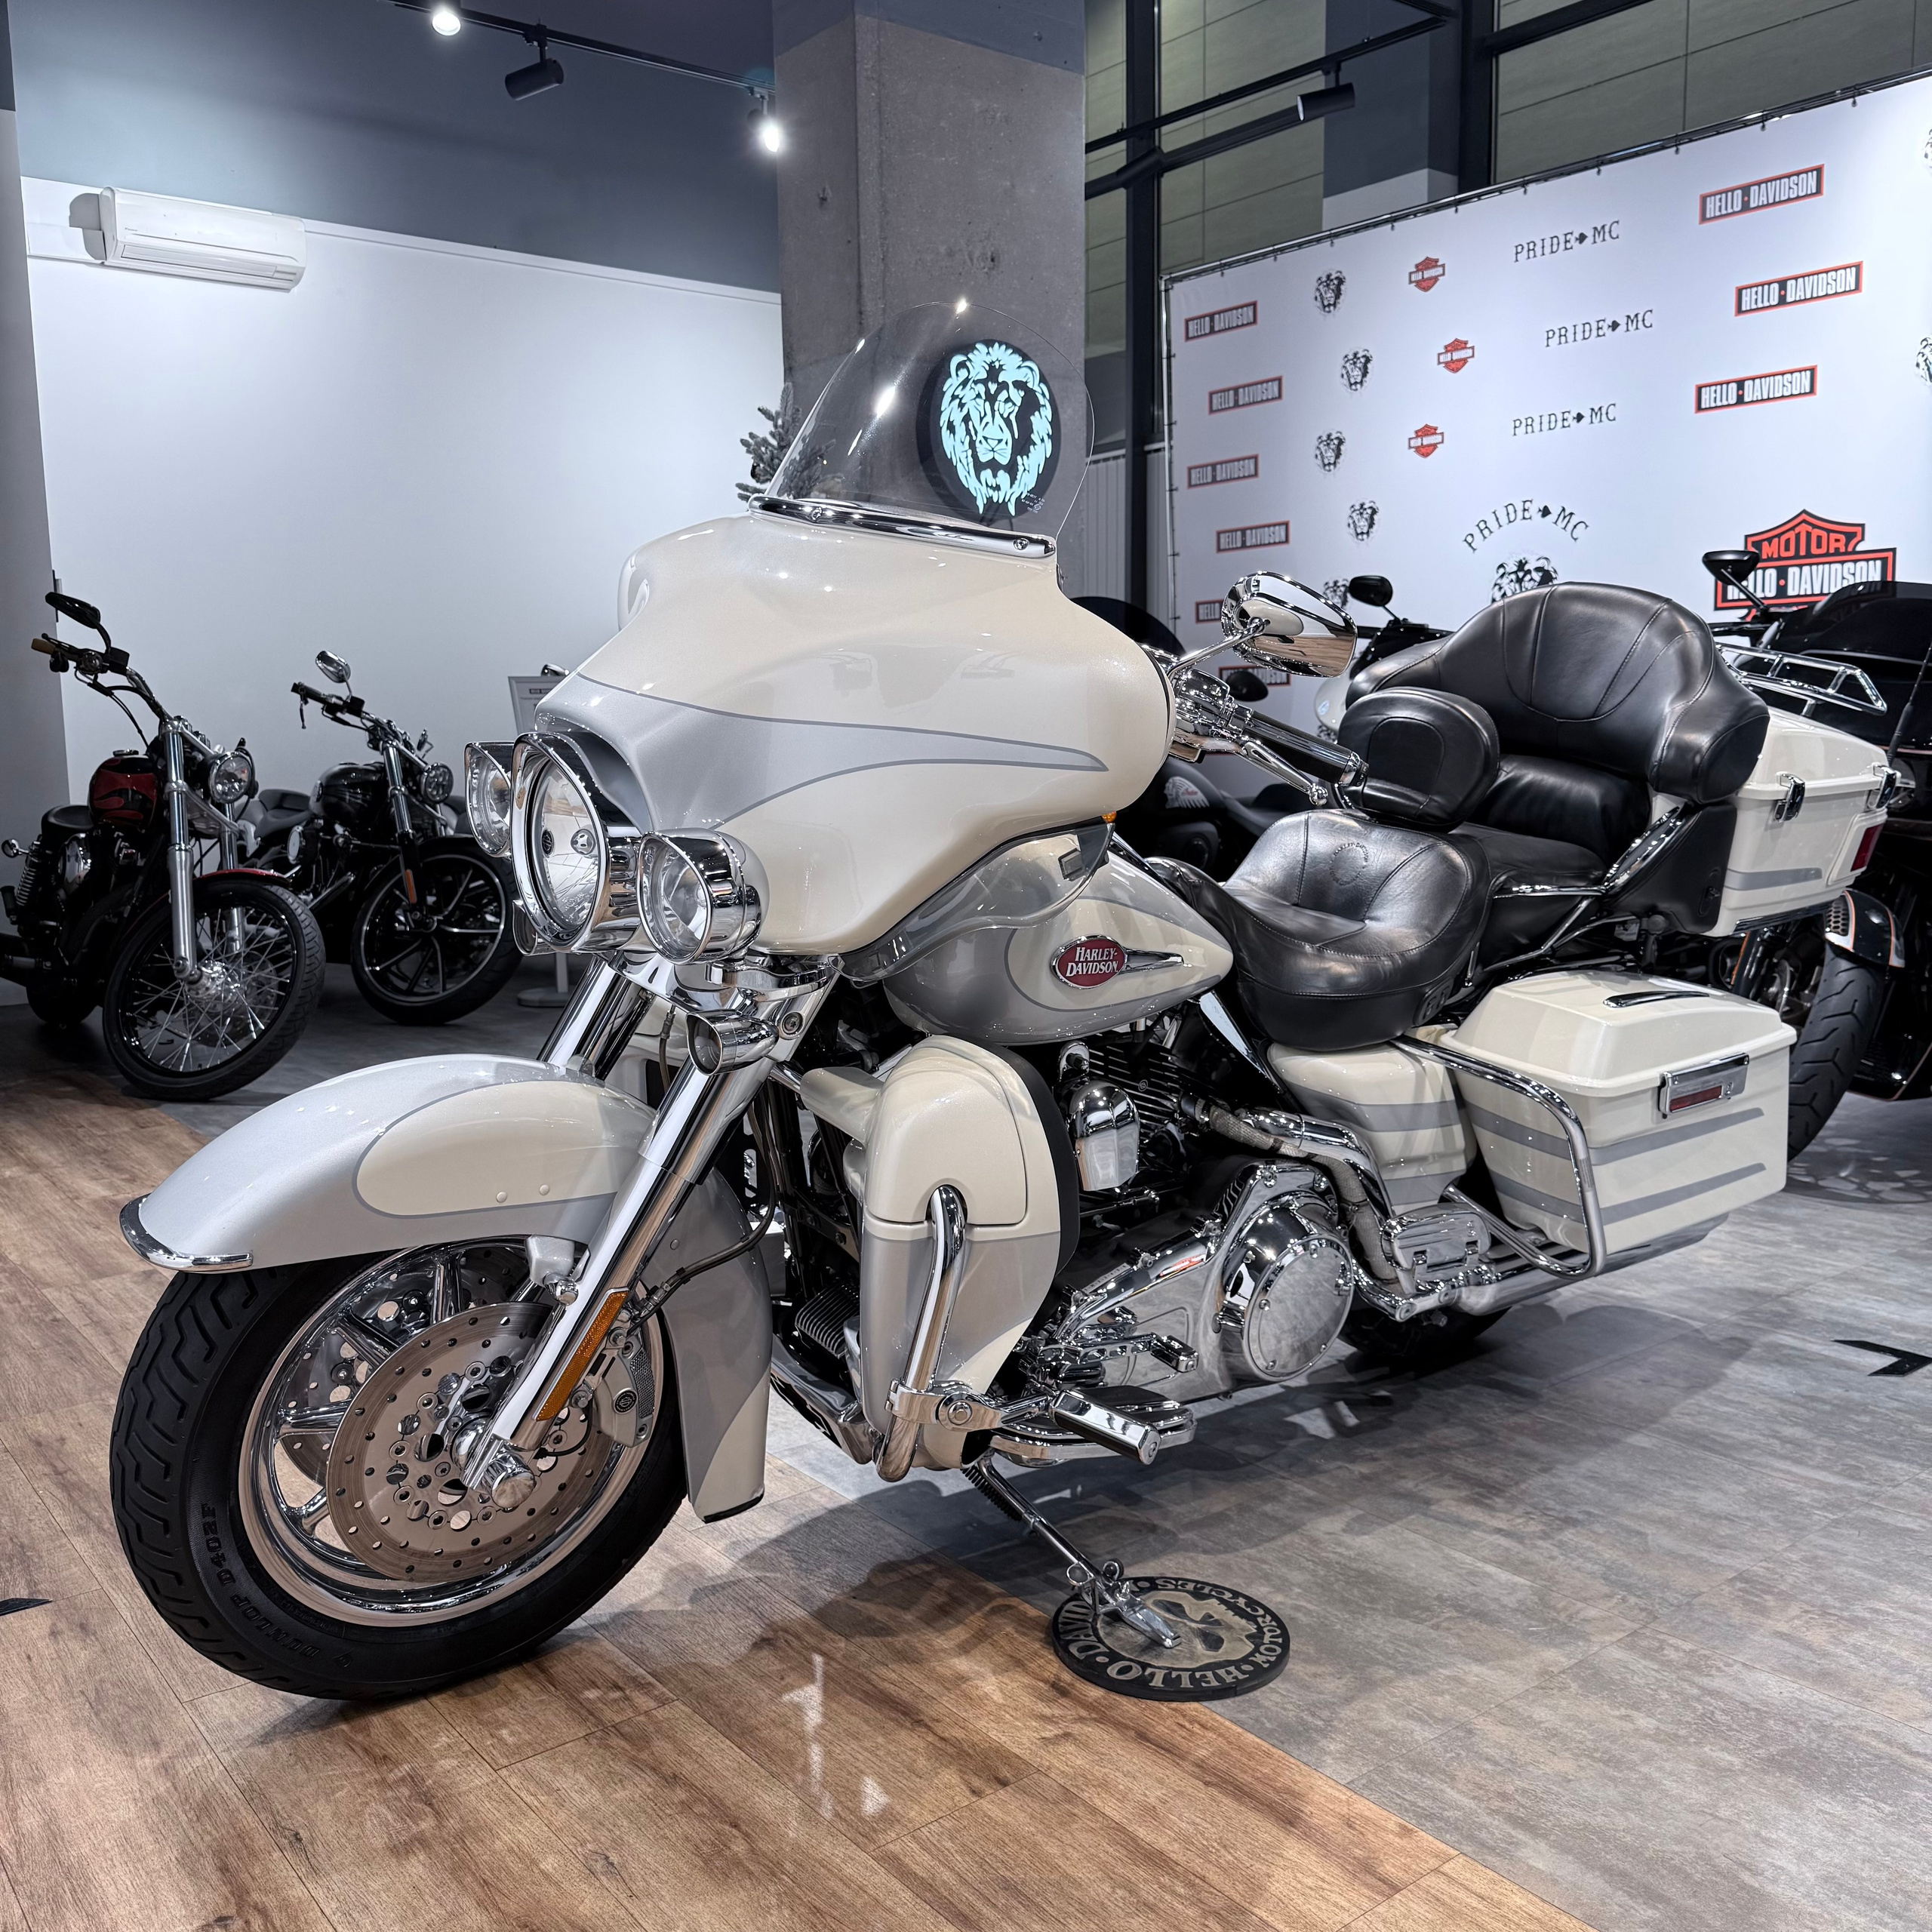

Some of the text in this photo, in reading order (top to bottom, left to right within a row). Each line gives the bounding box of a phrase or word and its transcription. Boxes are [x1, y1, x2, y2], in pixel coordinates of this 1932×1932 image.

[1706, 170, 1817, 219] HELLO DAVIDSON
[1514, 220, 1620, 263] PRIDE MC
[1741, 266, 1857, 312] HELLO DAVIDSON
[1187, 304, 1254, 338] HELLO DAVIDSON
[1545, 309, 1654, 348] PRIDE MC
[1211, 380, 1279, 411] HELLO DAVIDSON
[1700, 370, 1811, 409] HELLO DAVIDSON
[1512, 403, 1617, 436] PRIDE MC
[1462, 498, 1590, 554] PRIDE MC
[1761, 522, 1846, 559] MOTOR
[1787, 559, 1881, 596] DAVIDSON
[1066, 961, 1118, 977] DAVIDSON
[1075, 946, 1118, 961] HARLEY-
[201, 1503, 235, 1585] D402F
[229, 1593, 321, 1658] DUNLOP
[1155, 1578, 1283, 1669] MOTORCYCLES
[1106, 1660, 1249, 1687] HELLO
